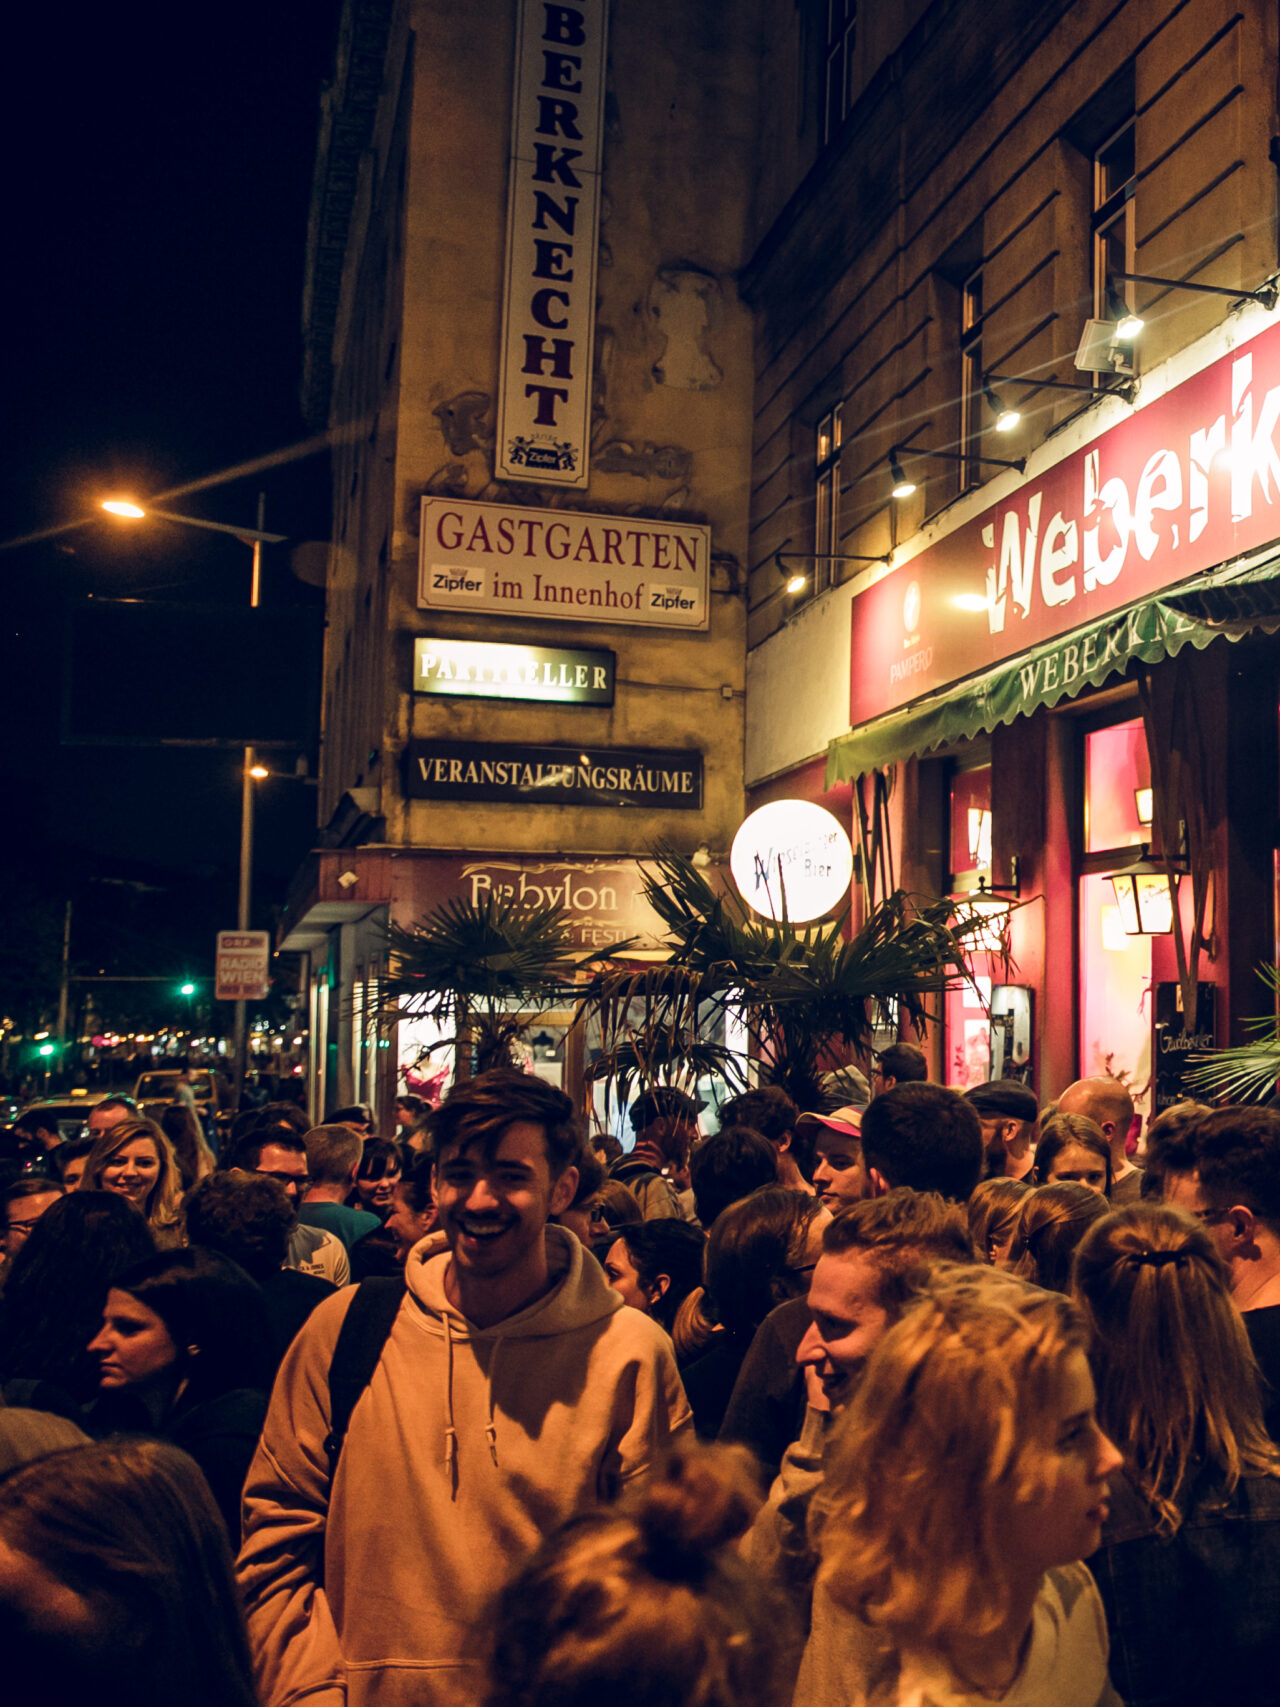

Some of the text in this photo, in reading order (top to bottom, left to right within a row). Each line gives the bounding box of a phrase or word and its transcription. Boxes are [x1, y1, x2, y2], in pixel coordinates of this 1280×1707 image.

[436, 511, 699, 573] GASTGARTEN
[432, 572, 696, 611] Zipfer im Innenhof Zipfer
[418, 757, 694, 794] VERANSTALTUNGSRÄUME
[219, 970, 267, 985] WIEN
[220, 957, 266, 971] RADIO
